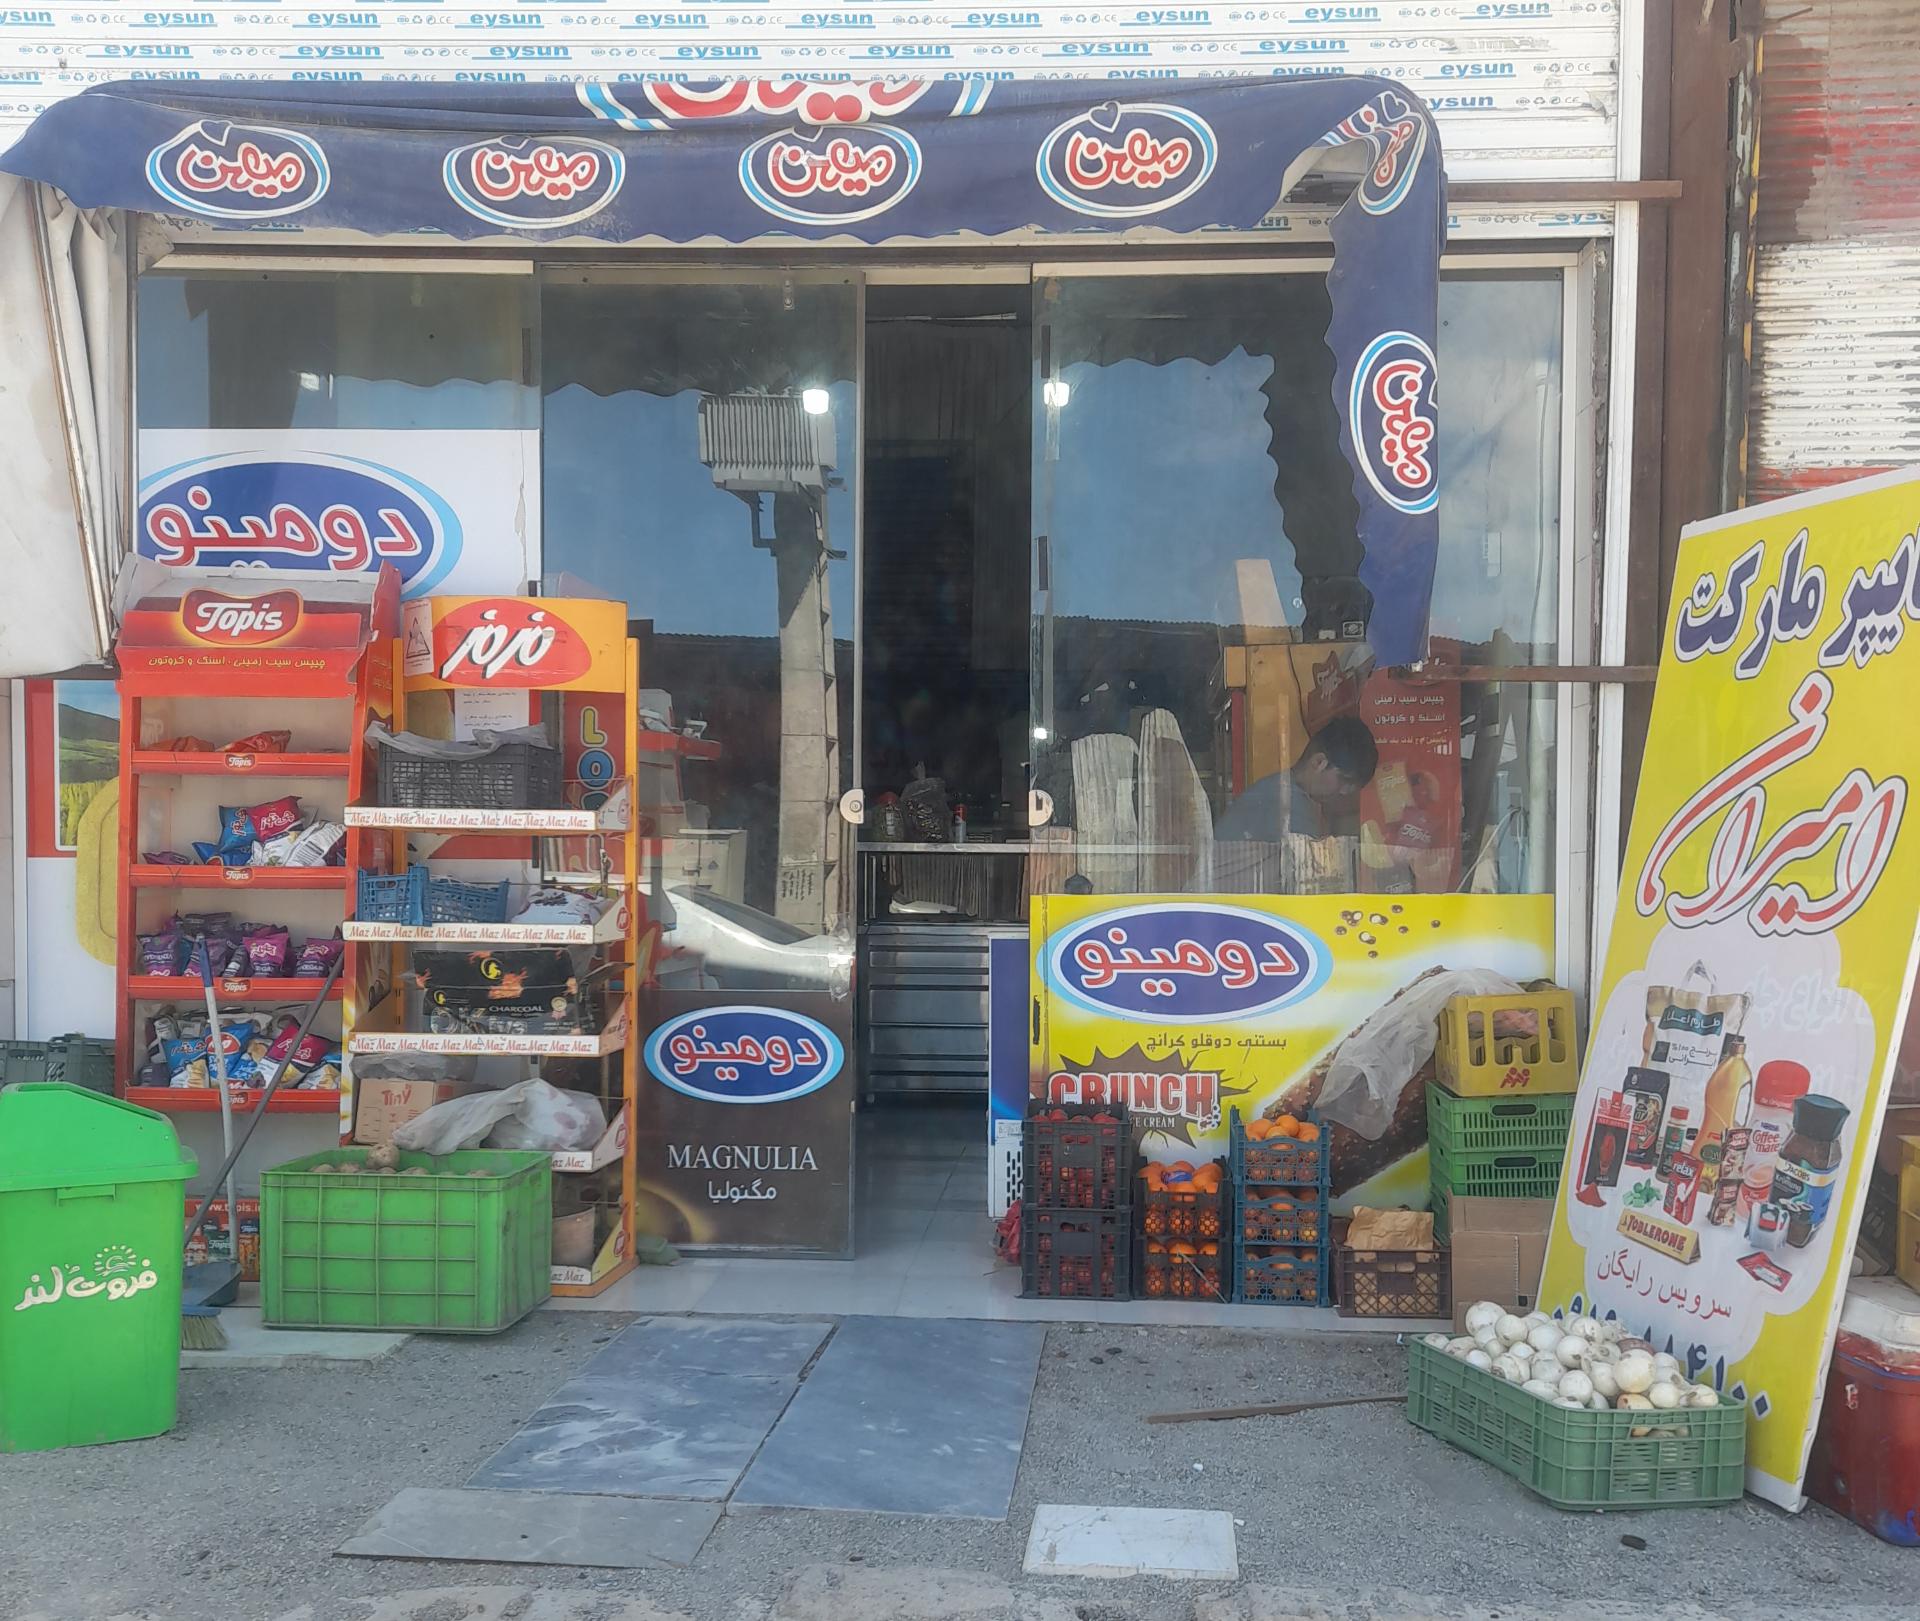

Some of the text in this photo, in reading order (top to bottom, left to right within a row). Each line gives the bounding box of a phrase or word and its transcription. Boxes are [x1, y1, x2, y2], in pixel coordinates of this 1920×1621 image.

[144, 11, 215, 25] eysun
[307, 12, 378, 27] eysun
[470, 12, 541, 28] eysun
[635, 13, 706, 28] eysun
[801, 13, 873, 28] eysun
[967, 12, 1040, 28] eysun
[1136, 11, 1209, 26] eysun
[1304, 5, 1379, 22] eysun
[1475, 1, 1550, 17] eysun
[104, 44, 190, 57] eysun
[297, 45, 381, 58] eysun
[489, 45, 568, 59] eysun
[677, 45, 758, 59] eysun
[868, 44, 950, 58] eysun
[1062, 41, 1148, 56] eysun
[1259, 37, 1346, 52] eysun
[1440, 61, 1514, 77] eysun
[1675, 531, 1824, 678] مارکت
[195, 602, 283, 637] Topis
[350, 926, 586, 940] Maz Maz Maz Maz Maz Maz Maz Maz Maz Maz Maz
[1075, 928, 1299, 996] دومینو
[489, 1005, 544, 1013] CHARCOAL
[355, 1039, 374, 1050] Maz
[377, 1039, 396, 1050] Maz
[398, 1039, 418, 1050] Maz
[420, 1039, 439, 1050] Maz
[441, 1039, 461, 1050] Maz
[506, 1040, 526, 1051] Maz
[528, 1040, 549, 1051] Maz
[551, 1040, 571, 1051] Maz
[572, 1040, 592, 1051] Maz
[1146, 1032, 1287, 1051] بستنی دوقلو کرانچ
[670, 1025, 821, 1080] دومینو
[1049, 1073, 1221, 1118] CRUNCH
[1143, 1116, 1175, 1128] CREAM
[1753, 1130, 1779, 1144] Coffee
[667, 1145, 819, 1170] MAGNULIA
[1756, 1143, 1779, 1152] mate
[565, 1157, 584, 1168] Maz
[1673, 1162, 1694, 1178] relax
[708, 1178, 777, 1203] مگنولیا
[1626, 1214, 1687, 1249] TOBLERONE
[564, 1270, 584, 1282] Maz
[1597, 1249, 1732, 1319] سرویس رایگان
